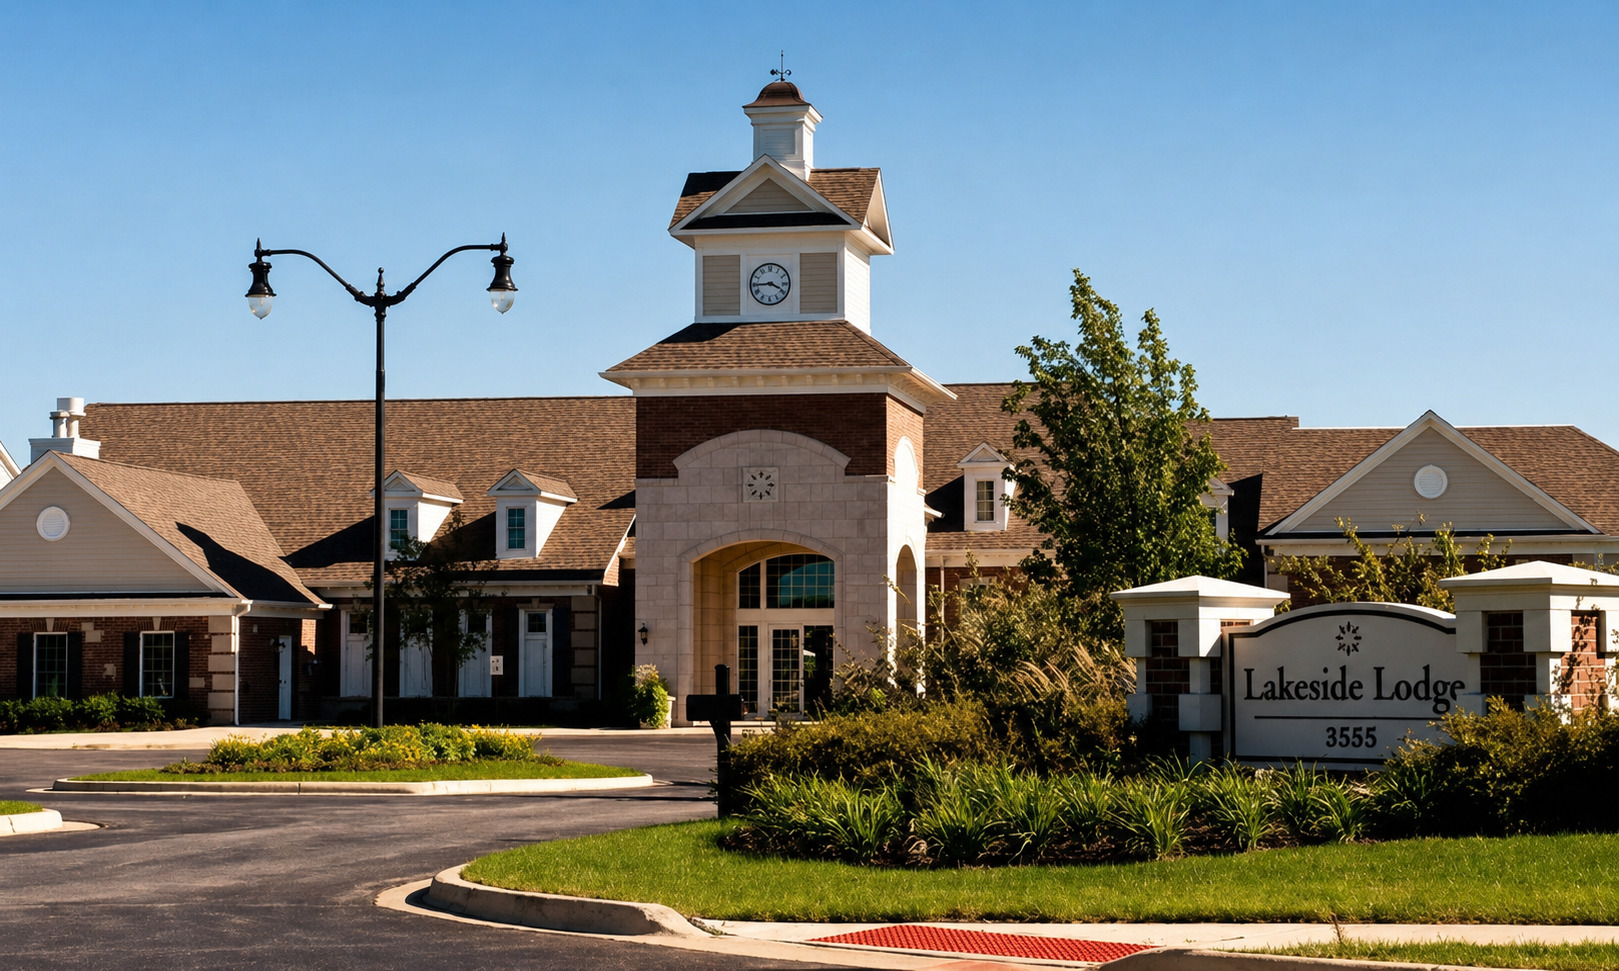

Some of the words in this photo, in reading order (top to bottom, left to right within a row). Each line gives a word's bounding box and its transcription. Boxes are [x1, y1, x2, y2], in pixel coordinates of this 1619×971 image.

[1243, 664, 1364, 701] Lakeside
[1373, 663, 1466, 715] Lodge
[1325, 726, 1378, 748] 3555
